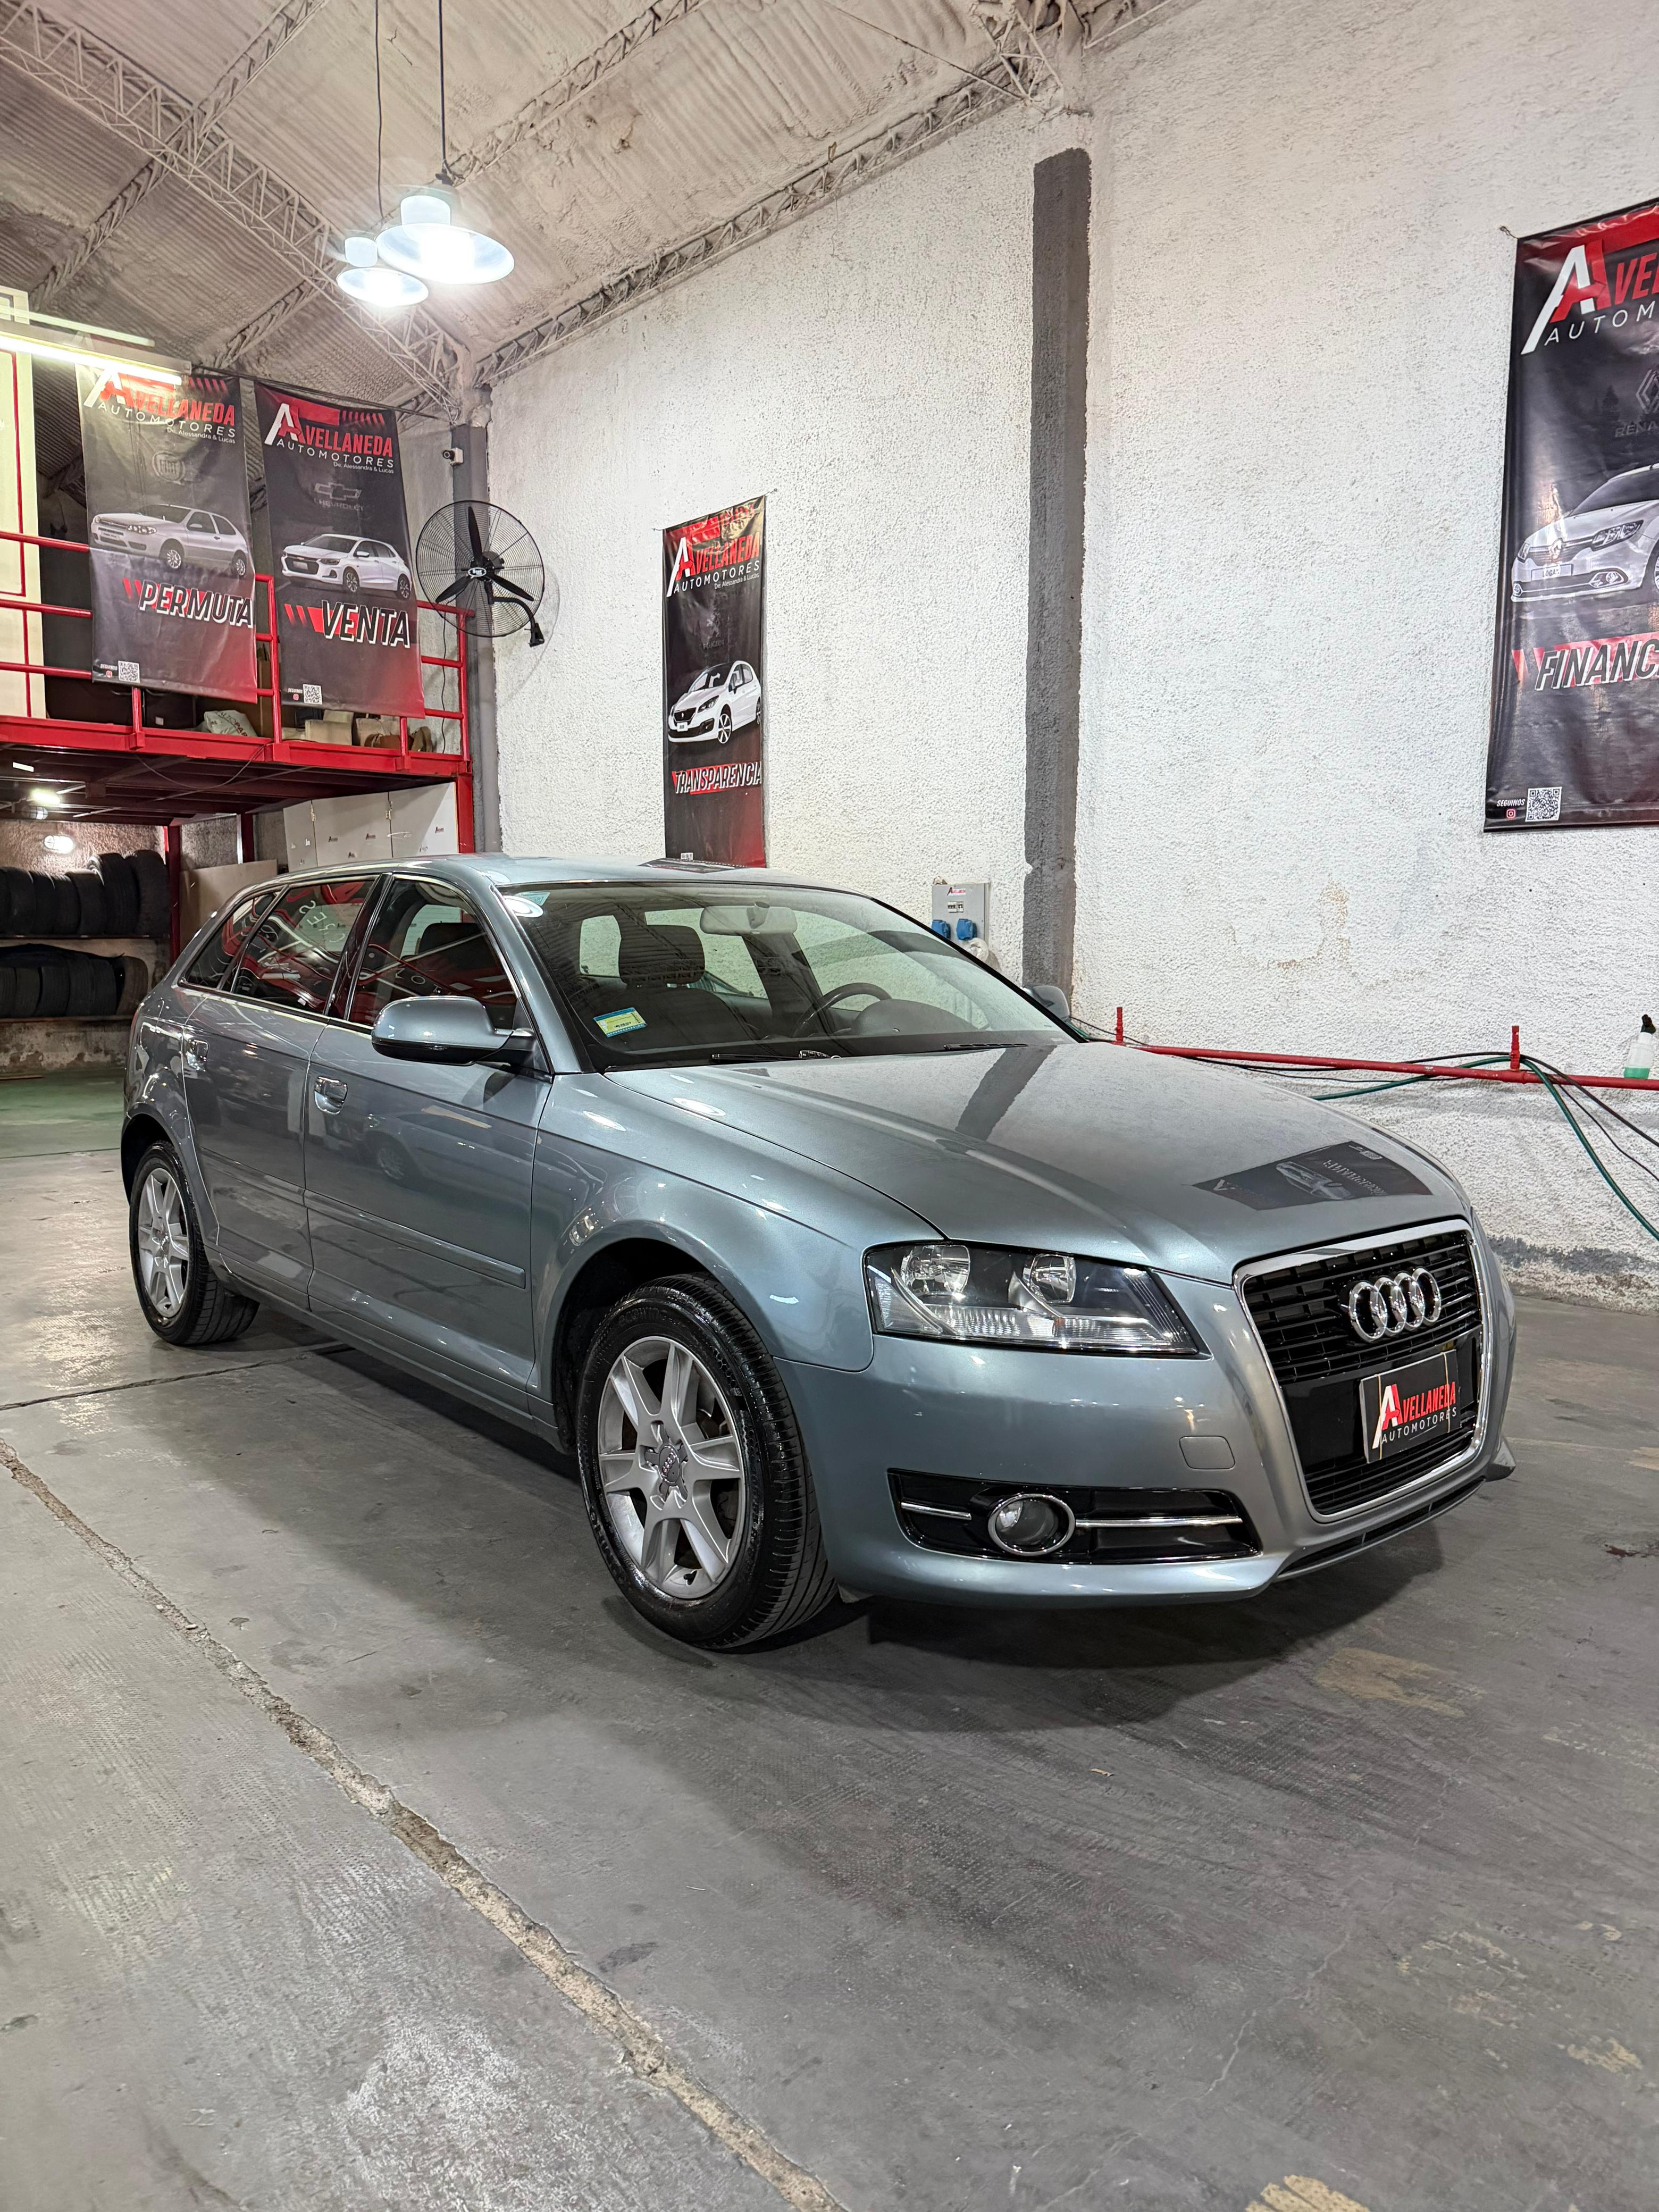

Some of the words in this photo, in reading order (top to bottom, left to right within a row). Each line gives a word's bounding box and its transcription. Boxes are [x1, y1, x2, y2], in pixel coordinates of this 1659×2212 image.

[83, 367, 235, 426] AVELLANEDA
[97, 401, 236, 438] AUTOMOTORES
[219, 436, 236, 445] Lucas
[264, 403, 393, 458] AVELLANEDA
[276, 438, 395, 468] AUTOMOTORES
[666, 531, 760, 597] AVELLANEDA
[673, 560, 761, 594] AUTOMOTORES
[747, 572, 760, 581] Lucas
[138, 579, 254, 629] PERMUTA
[321, 599, 411, 649] VENTA
[1534, 638, 1659, 692] FINANC
[1496, 798, 1526, 807] SEGUINOS
[1372, 1381, 1456, 1449] AVELLANEDA
[1381, 1406, 1457, 1445] AUTOMOTORES
